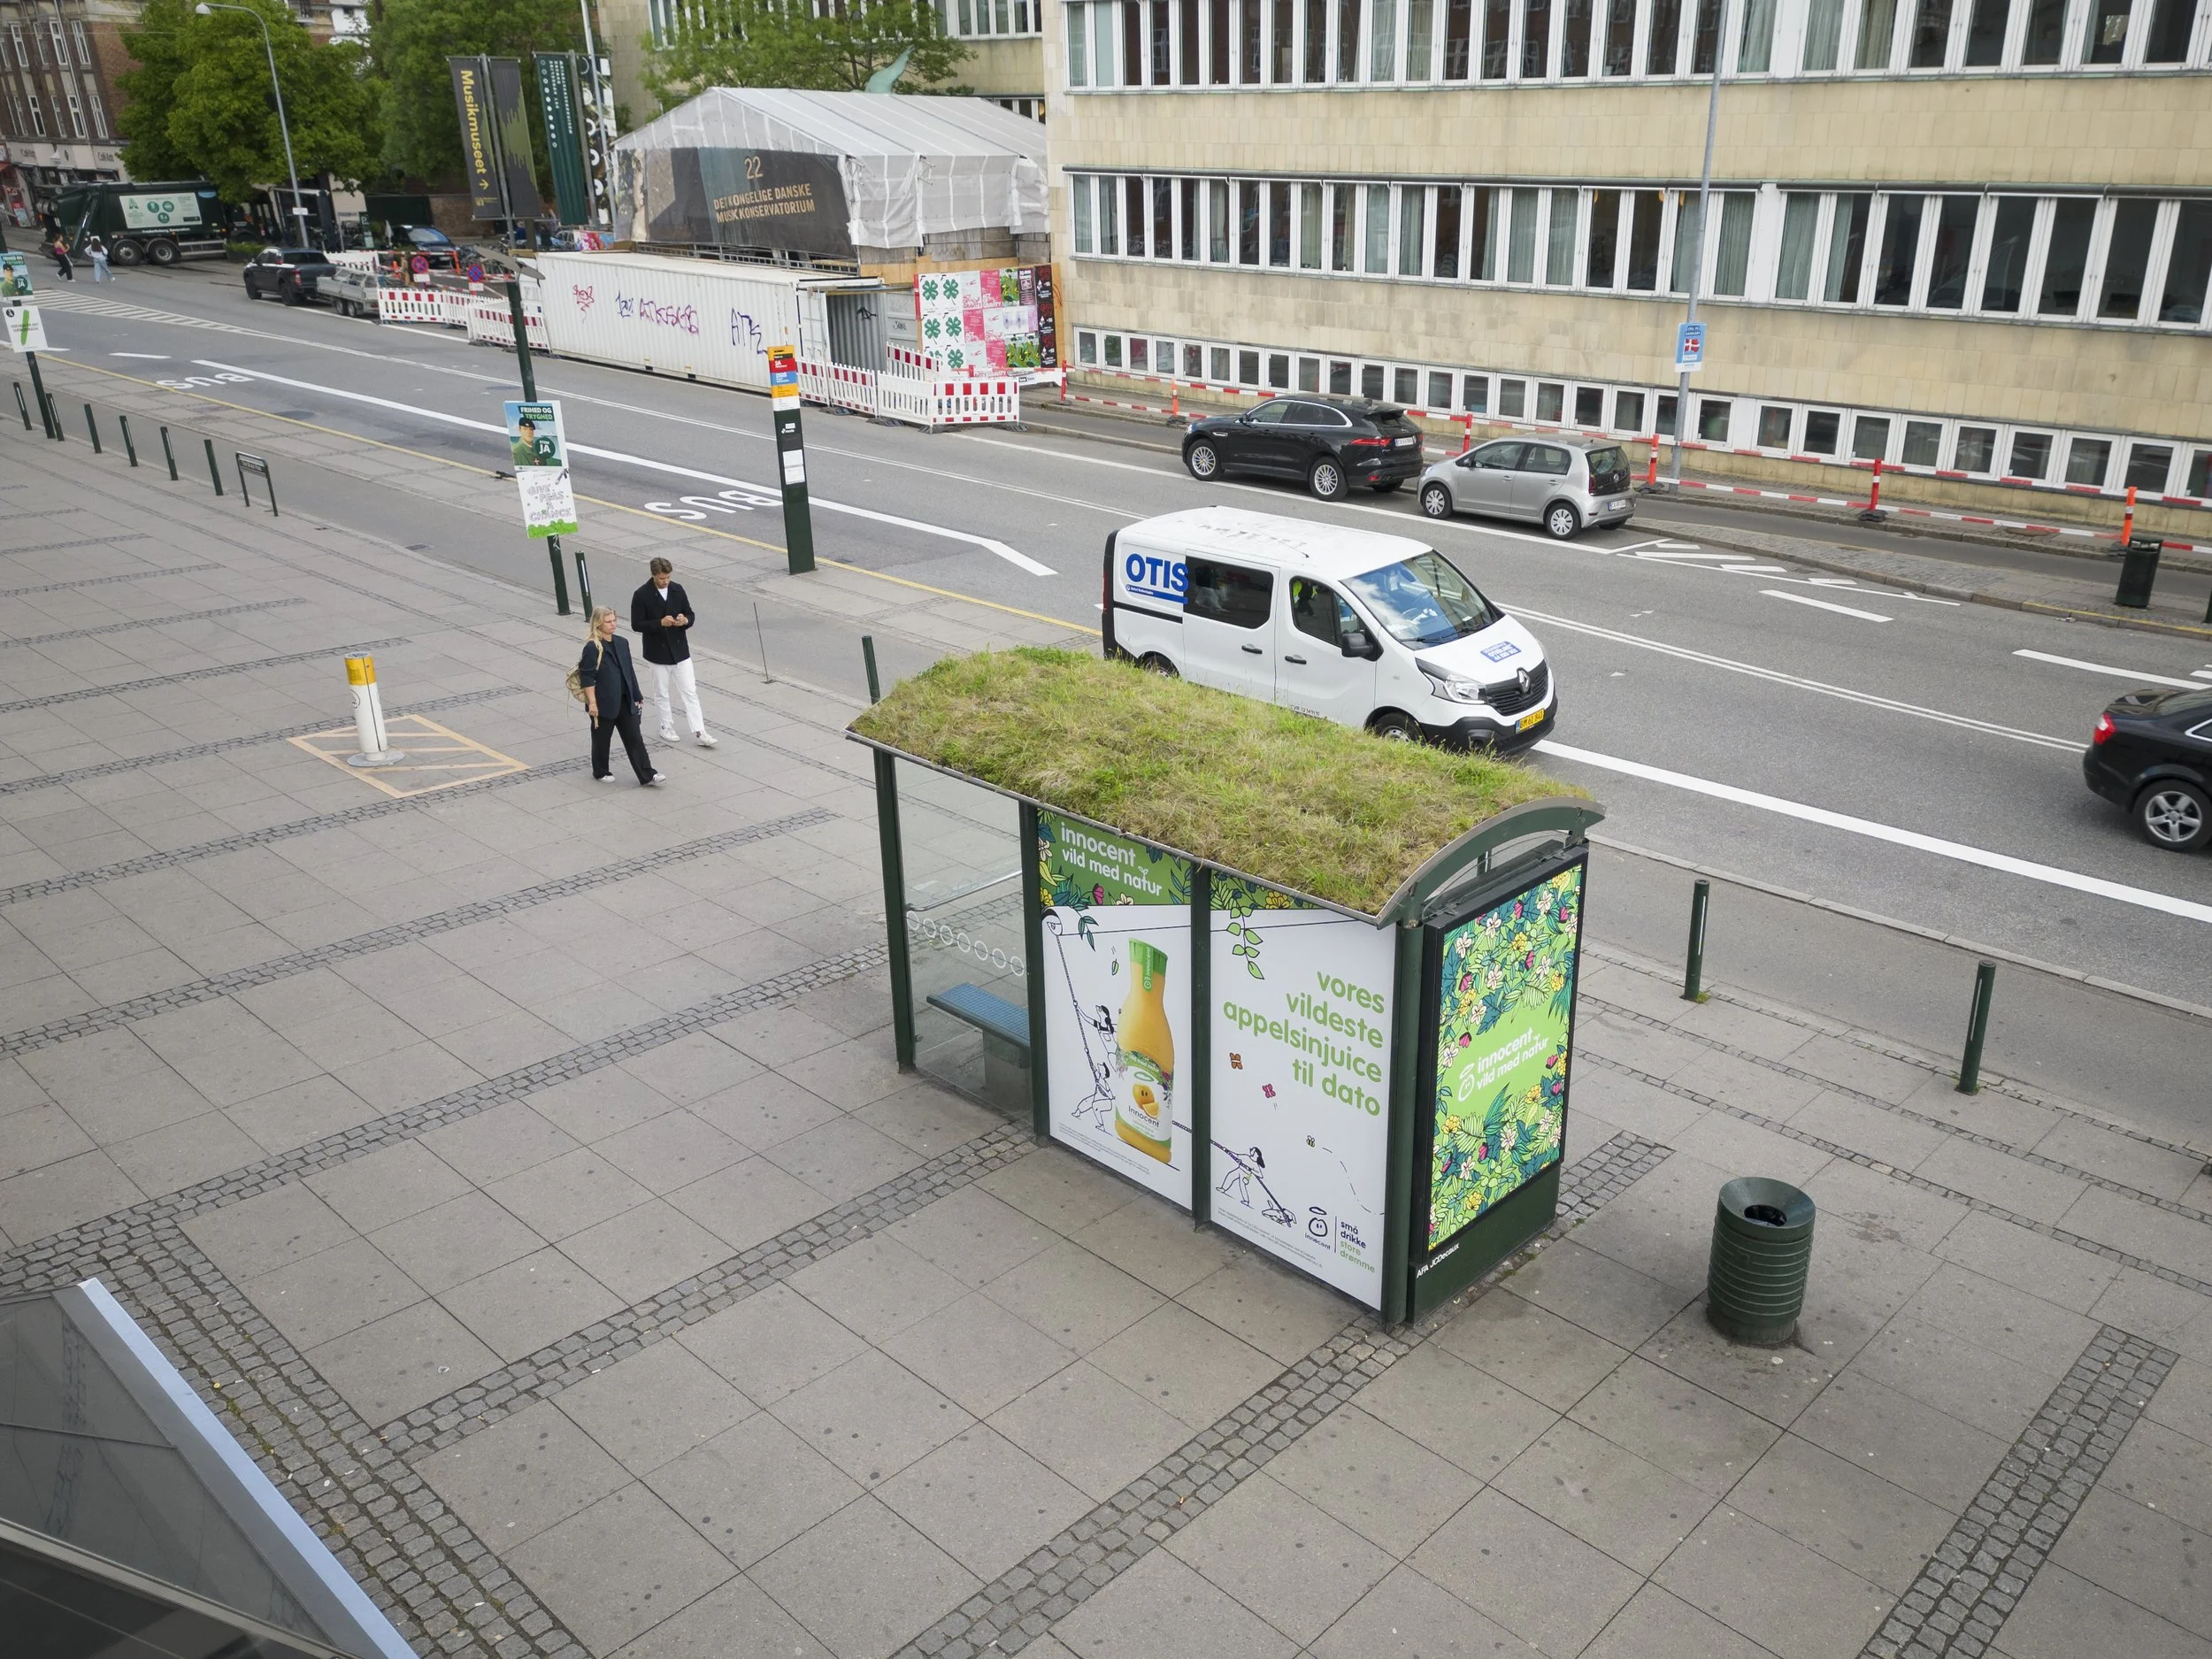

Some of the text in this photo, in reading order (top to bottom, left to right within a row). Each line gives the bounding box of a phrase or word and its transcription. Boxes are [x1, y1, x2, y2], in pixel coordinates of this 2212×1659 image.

[460, 70, 487, 174] Musikmuseet
[744, 156, 763, 180] 22
[727, 188, 773, 208] KONGELIGE
[774, 183, 811, 200] DANSKE
[738, 199, 816, 220] KONSERVATORIUM
[156, 373, 255, 389] BUS
[538, 443, 551, 455] JA
[539, 490, 565, 503] PEAS
[644, 489, 784, 520] BUS
[1125, 553, 1189, 592] OTIS
[1061, 822, 1136, 867] innocent
[1062, 848, 1163, 896] vild med natur
[1317, 971, 1385, 1014] vores
[1286, 992, 1384, 1048] vildeste
[1223, 1001, 1382, 1083] appelsinjuice
[1478, 1027, 1533, 1073] innocent
[1477, 1033, 1549, 1090] vild med natur
[1292, 1058, 1380, 1117] til dato
[1128, 1104, 1160, 1128] innocent
[1304, 1233, 1331, 1250] innocent
[1340, 1220, 1359, 1235] små
[1340, 1231, 1367, 1249] drikke
[1340, 1240, 1362, 1256] store
[1340, 1251, 1375, 1273] drømme
[1417, 1242, 1459, 1279] AFA JCDecaux
